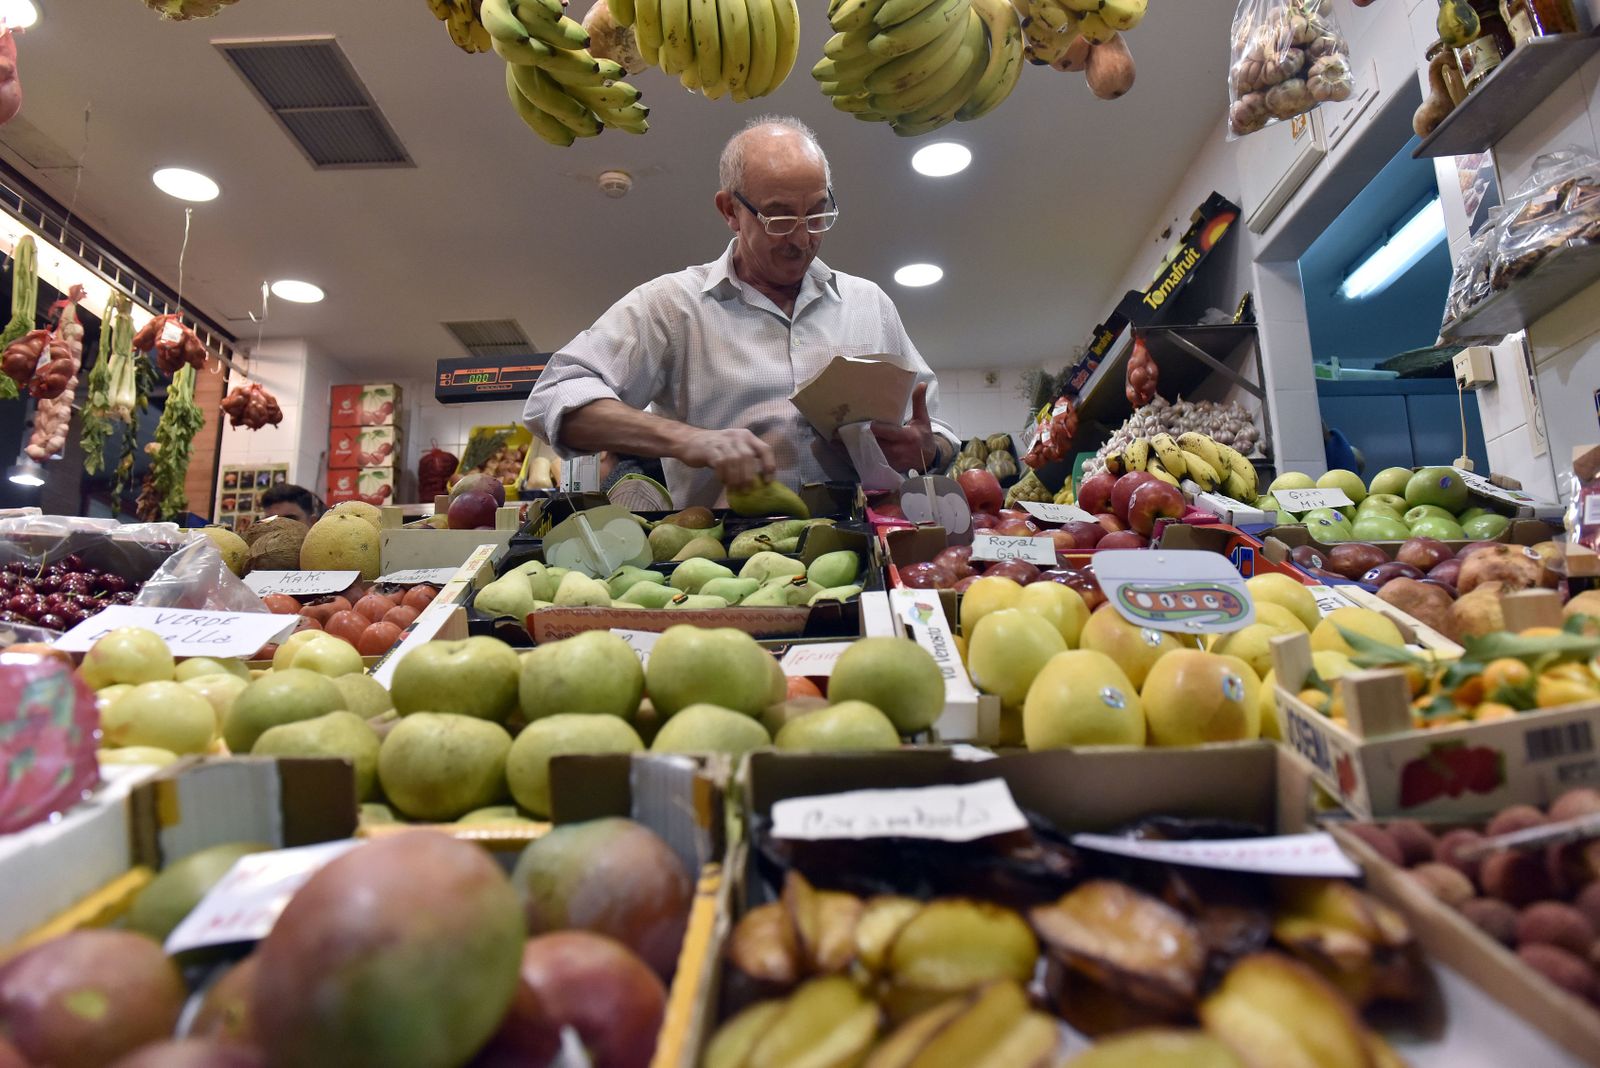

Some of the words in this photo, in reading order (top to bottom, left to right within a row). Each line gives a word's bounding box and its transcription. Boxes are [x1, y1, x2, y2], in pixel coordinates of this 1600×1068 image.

[1143, 246, 1201, 310] Tornafruit
[989, 536, 1038, 549] Royal
[996, 547, 1038, 560] Gala
[154, 612, 240, 627] VERDE
